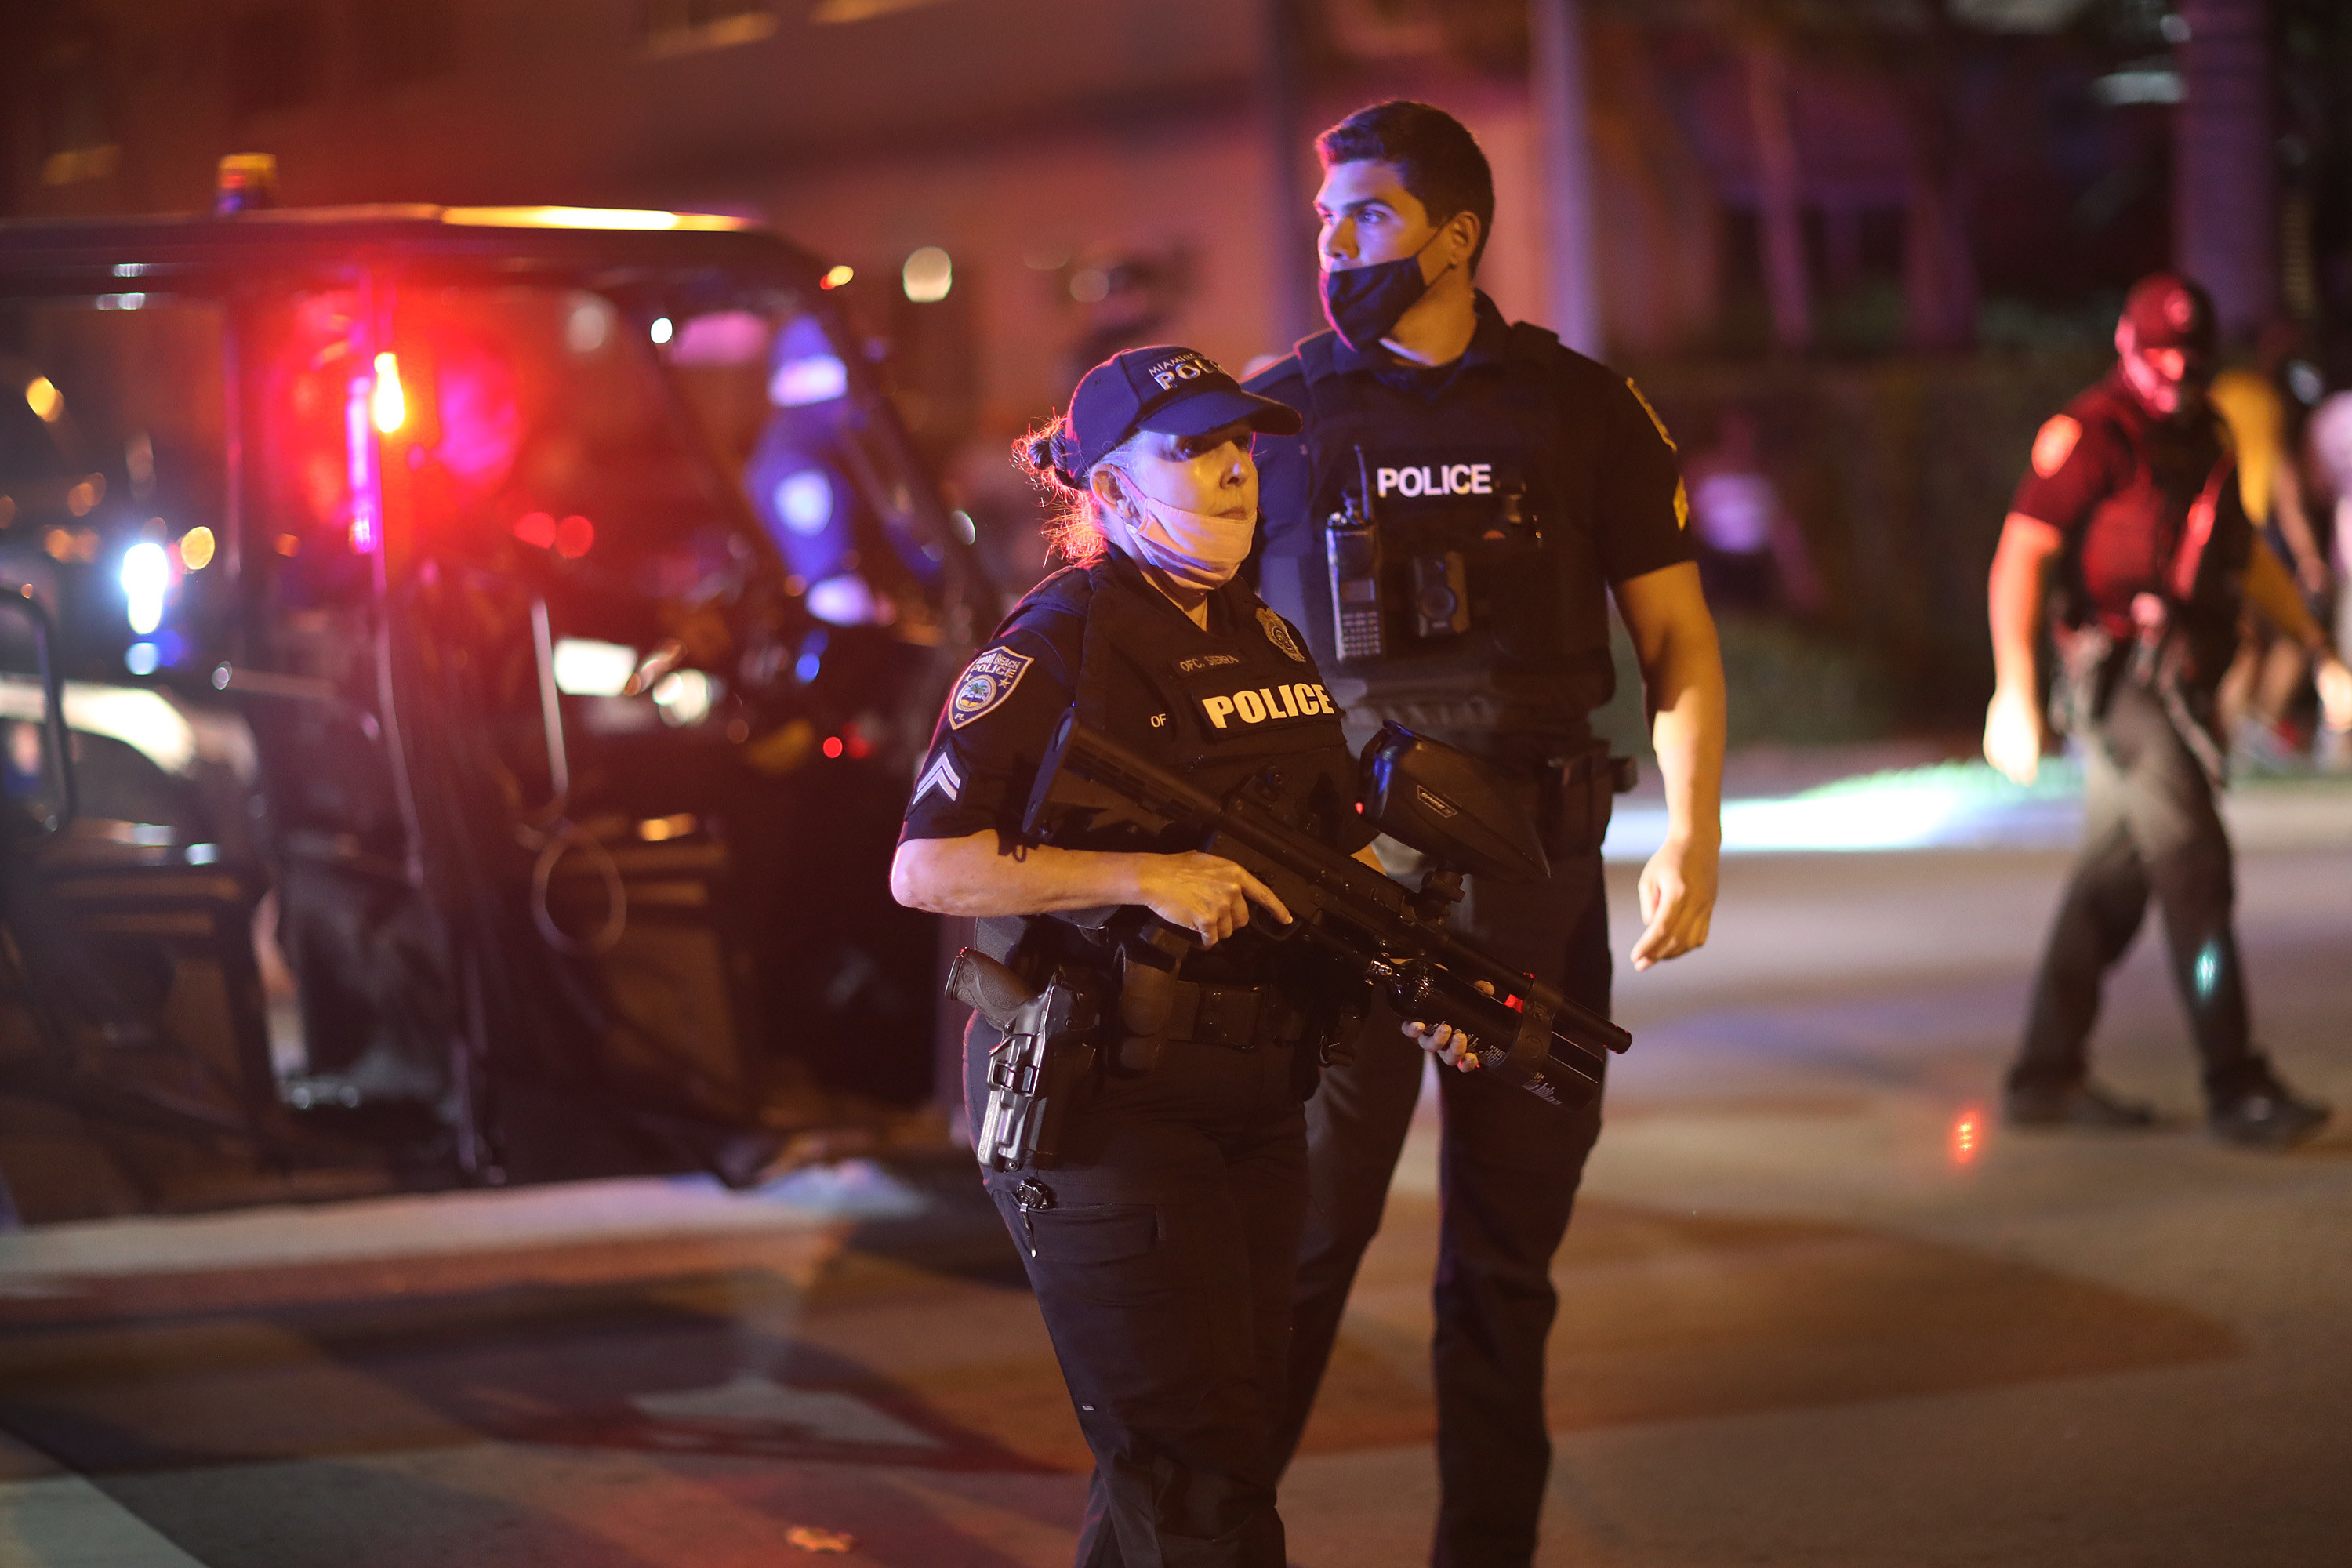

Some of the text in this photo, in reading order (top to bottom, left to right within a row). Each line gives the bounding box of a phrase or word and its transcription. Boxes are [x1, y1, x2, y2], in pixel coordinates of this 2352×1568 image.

[1377, 463, 1493, 498] POLICE
[993, 653, 1022, 670] BEACH
[970, 663, 1018, 679] POLICE
[1202, 683, 1335, 729] POLICE
[954, 713, 965, 721] FL
[1150, 713, 1167, 728] OF
